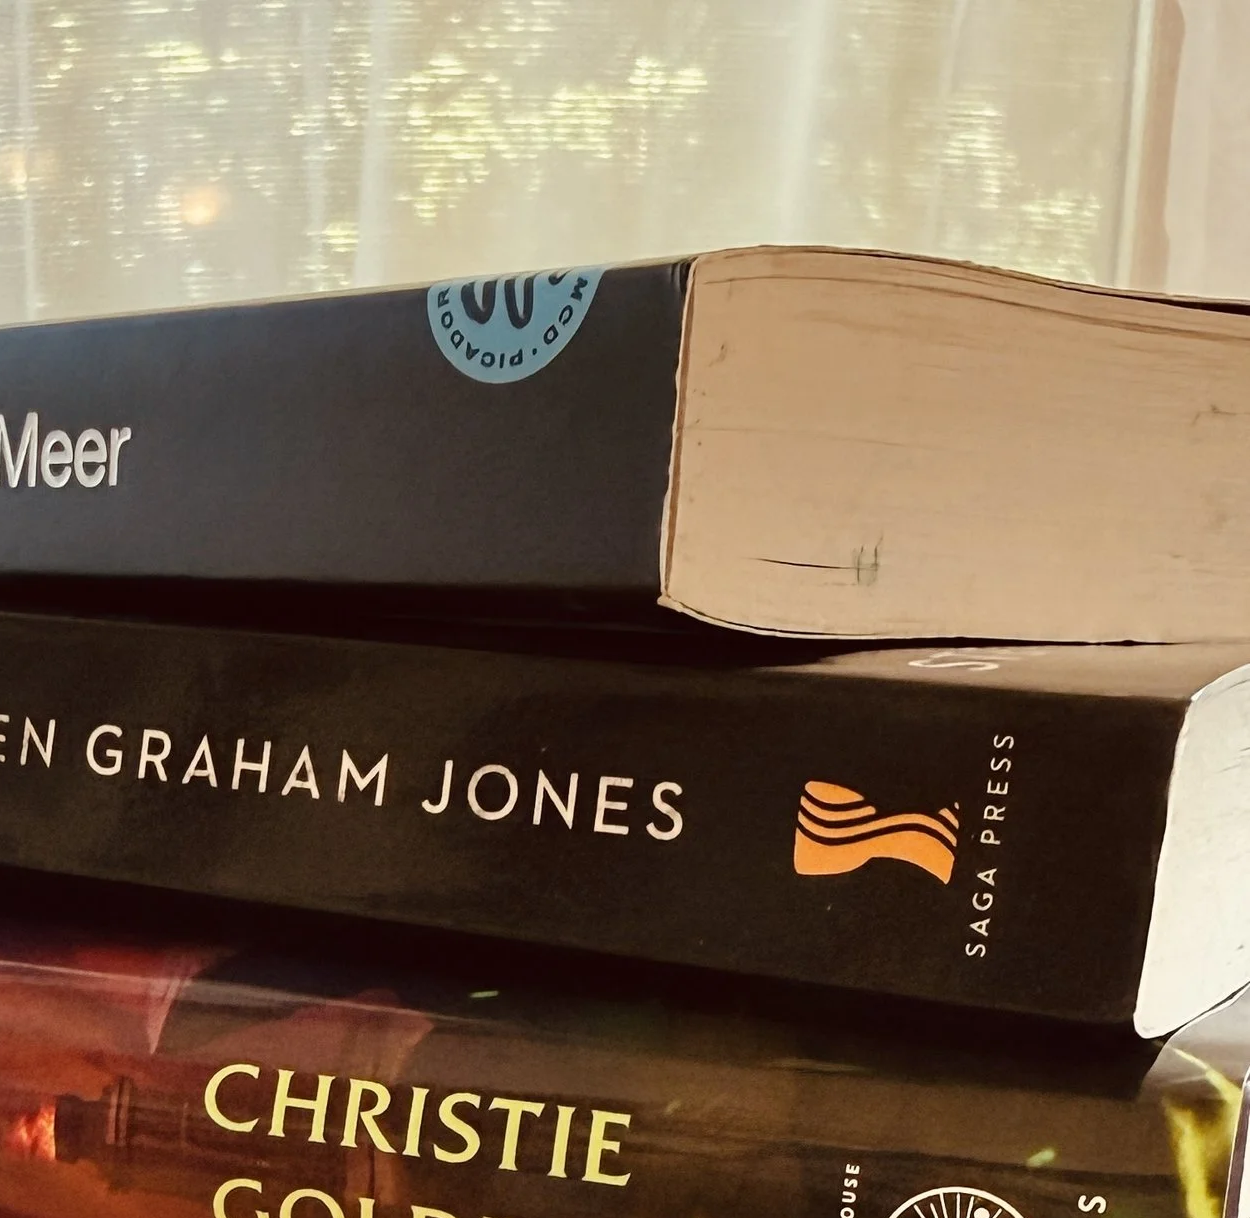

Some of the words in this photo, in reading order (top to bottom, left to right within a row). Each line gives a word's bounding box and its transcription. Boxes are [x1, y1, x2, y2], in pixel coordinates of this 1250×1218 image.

[437, 286, 523, 369] PICADOR
[85, 725, 390, 808] GRAHAM
[421, 759, 686, 842] JONES
[980, 733, 1015, 845] PRESS
[965, 867, 998, 958] SAGA
[204, 1063, 632, 1187] CHRISTIE
